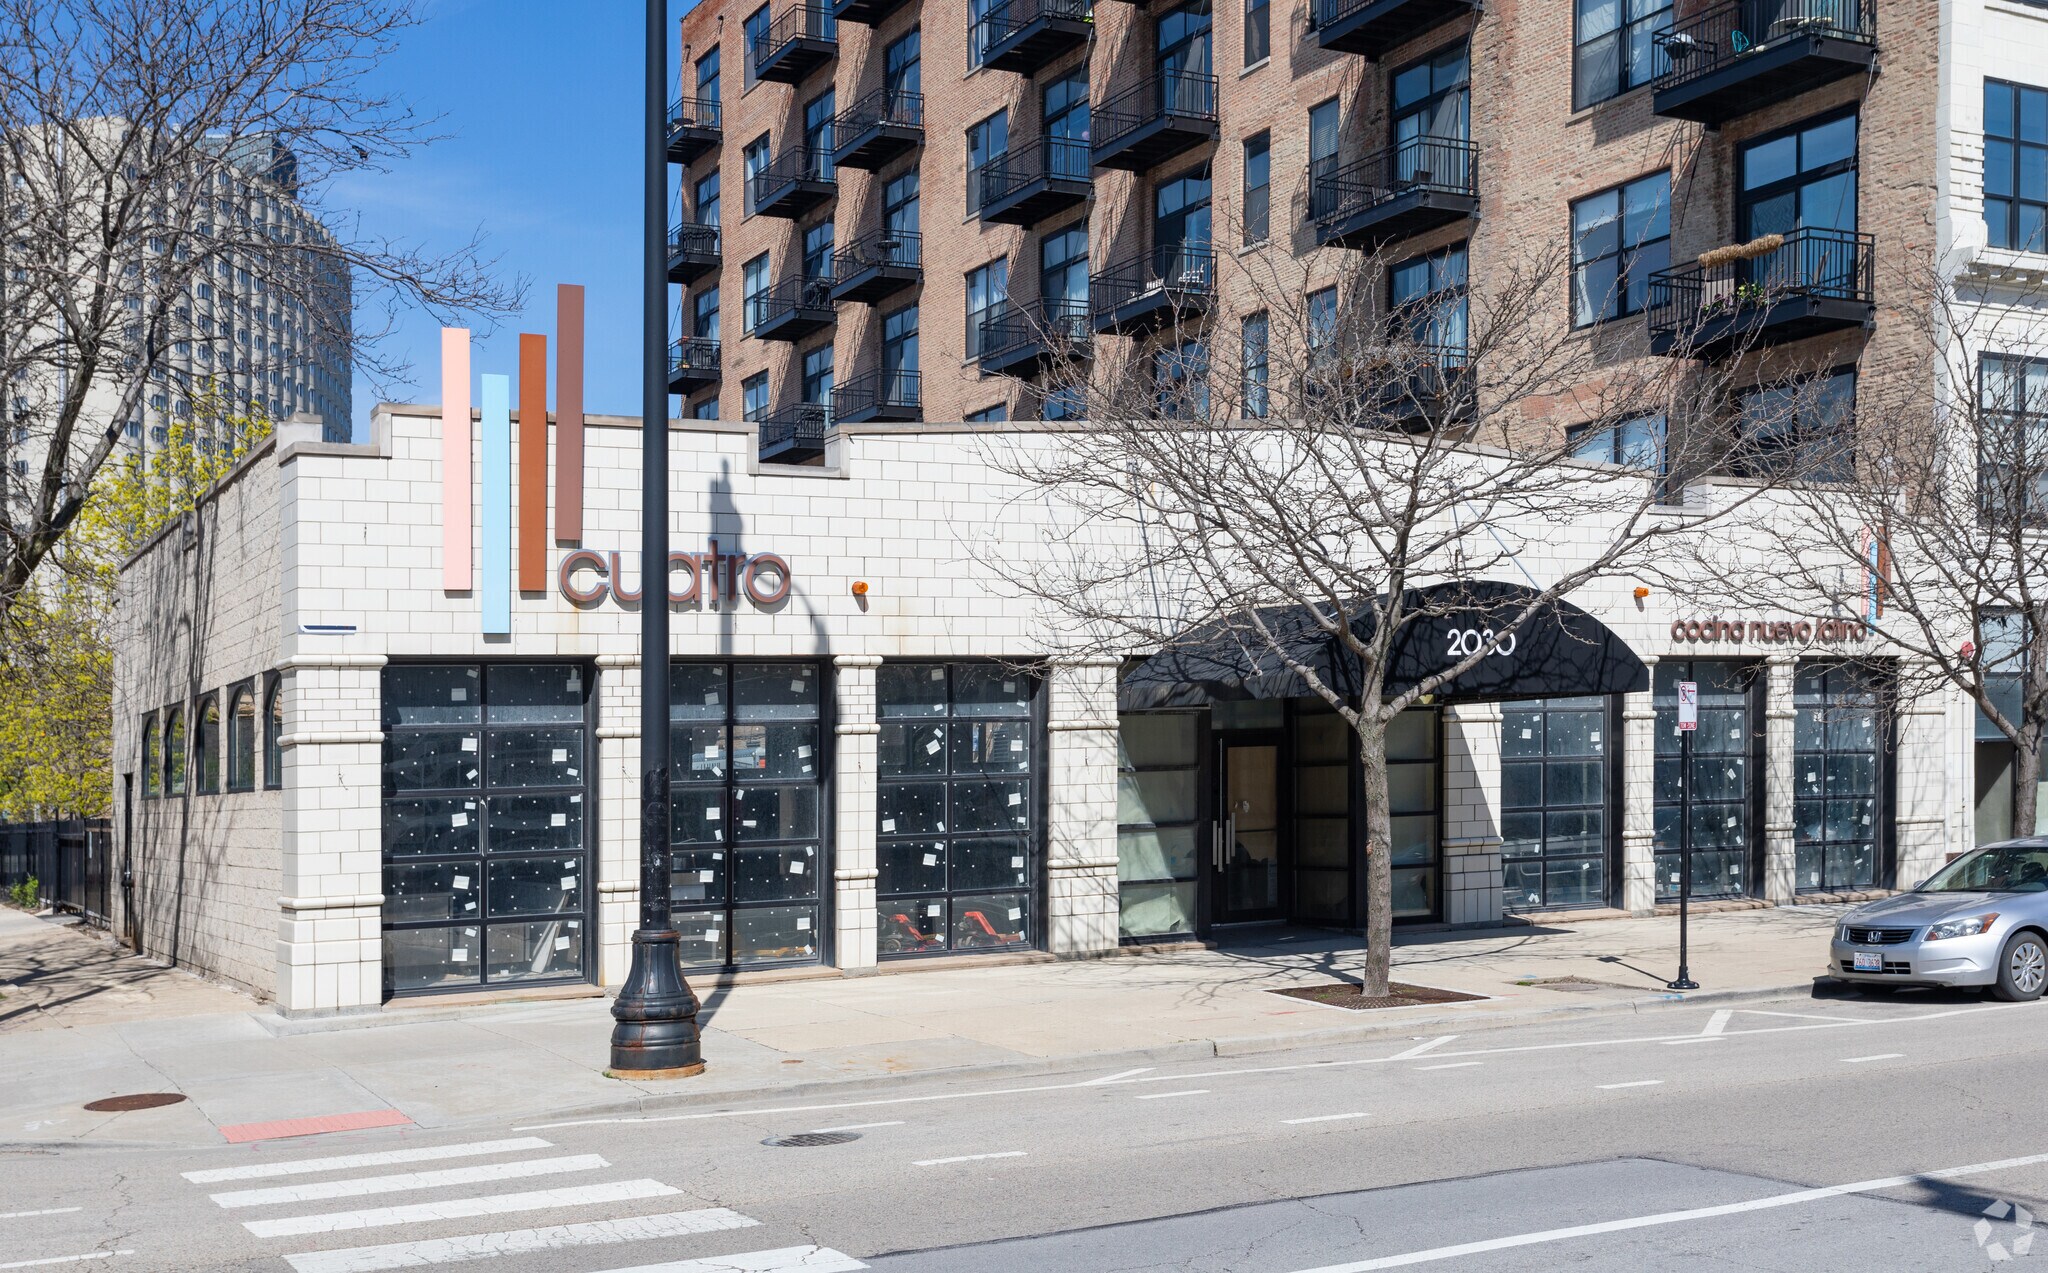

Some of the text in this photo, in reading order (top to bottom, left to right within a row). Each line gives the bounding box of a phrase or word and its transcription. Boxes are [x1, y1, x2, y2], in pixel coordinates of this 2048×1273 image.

[558, 536, 791, 604] cuatro
[1671, 615, 1867, 643] cocina nuevo latino
